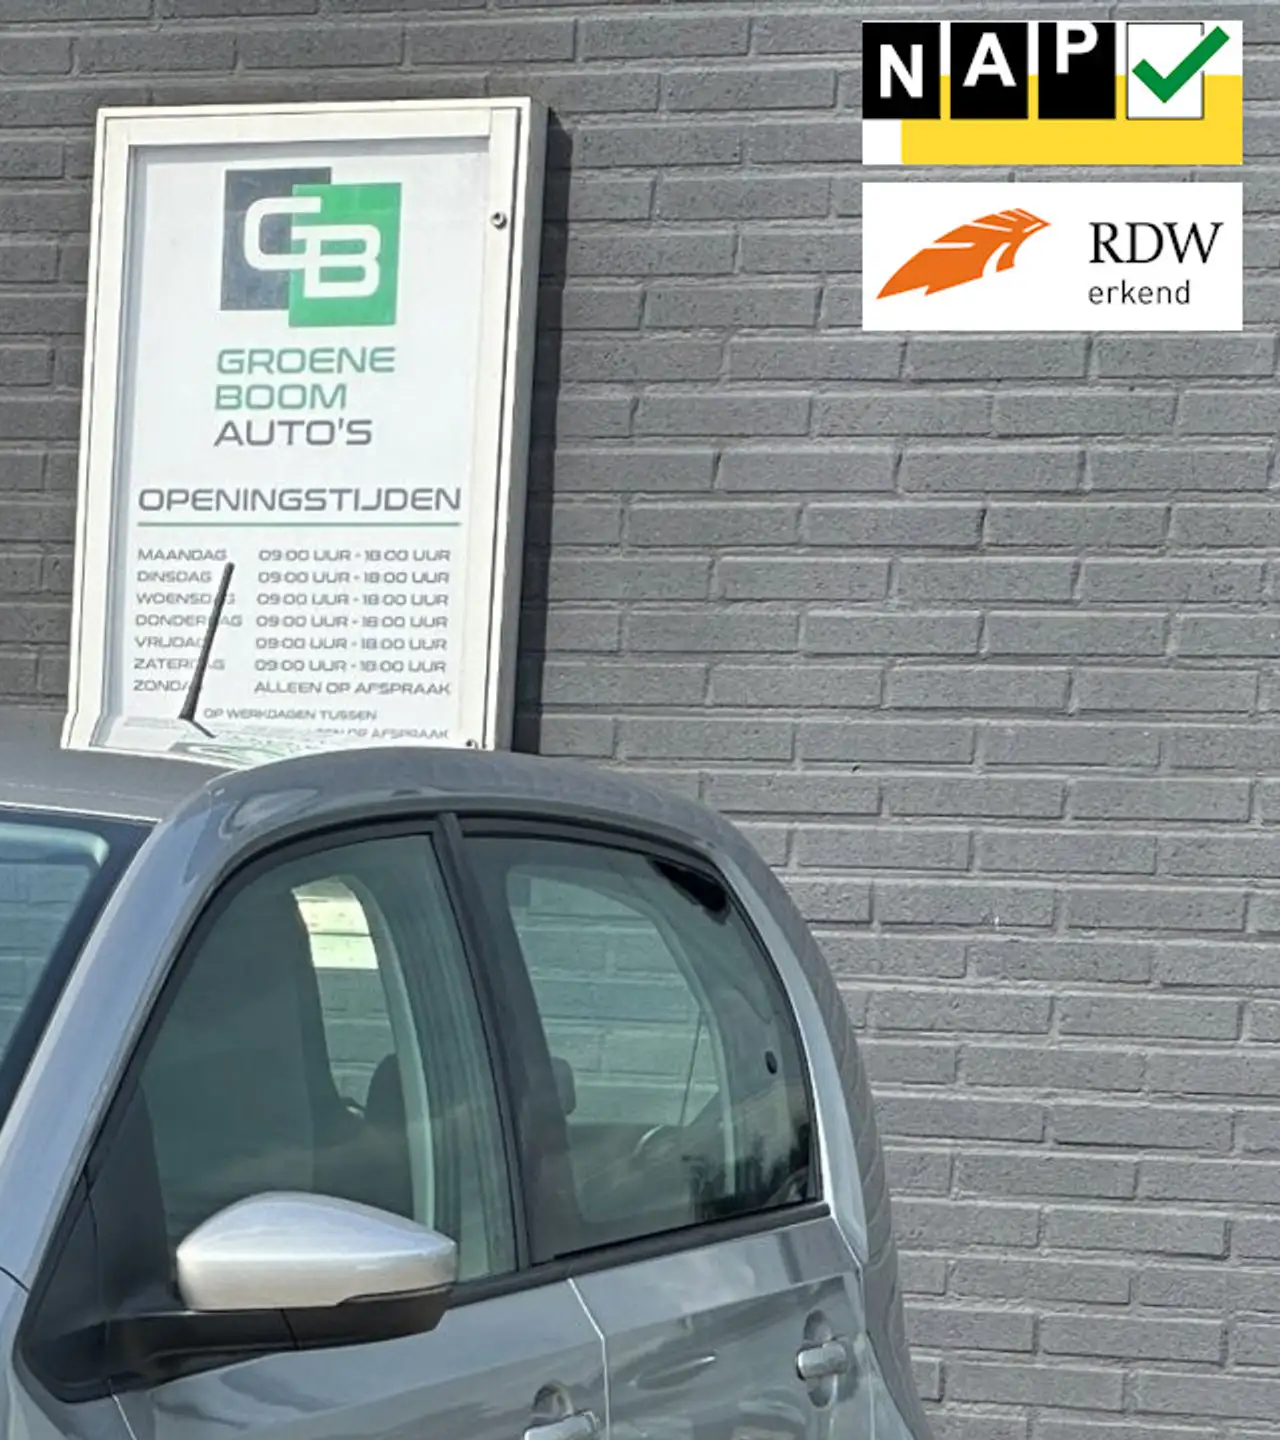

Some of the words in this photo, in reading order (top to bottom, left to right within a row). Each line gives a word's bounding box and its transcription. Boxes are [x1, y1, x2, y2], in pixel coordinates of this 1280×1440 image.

[216, 346, 396, 375] GROENE
[215, 383, 348, 411] BOOM
[214, 418, 373, 447] AUTO'S
[139, 487, 461, 512] OPENINGSTIJDEN
[138, 548, 228, 561] MAANDAG
[313, 549, 351, 562] UUR
[413, 549, 451, 562] UUR
[136, 570, 212, 582] DINSDAG
[312, 571, 350, 584] UUR
[412, 571, 450, 584] UUR
[136, 592, 236, 605] WOENSDG
[312, 593, 349, 606] UUR
[411, 593, 449, 606] UUR
[135, 614, 242, 627] DONDERAG
[311, 615, 349, 628] UUR
[410, 615, 448, 628] UUR
[309, 637, 347, 650] UUR
[408, 637, 447, 650] UUR
[308, 659, 347, 672] UUR
[408, 659, 447, 672] UUR
[254, 681, 322, 694] ALLEEN
[326, 682, 351, 694] OP
[354, 681, 451, 695] AFSPRAAK
[203, 708, 224, 720] OP
[226, 708, 316, 720] WERKDAGEN
[319, 709, 377, 721] TUSSEN
